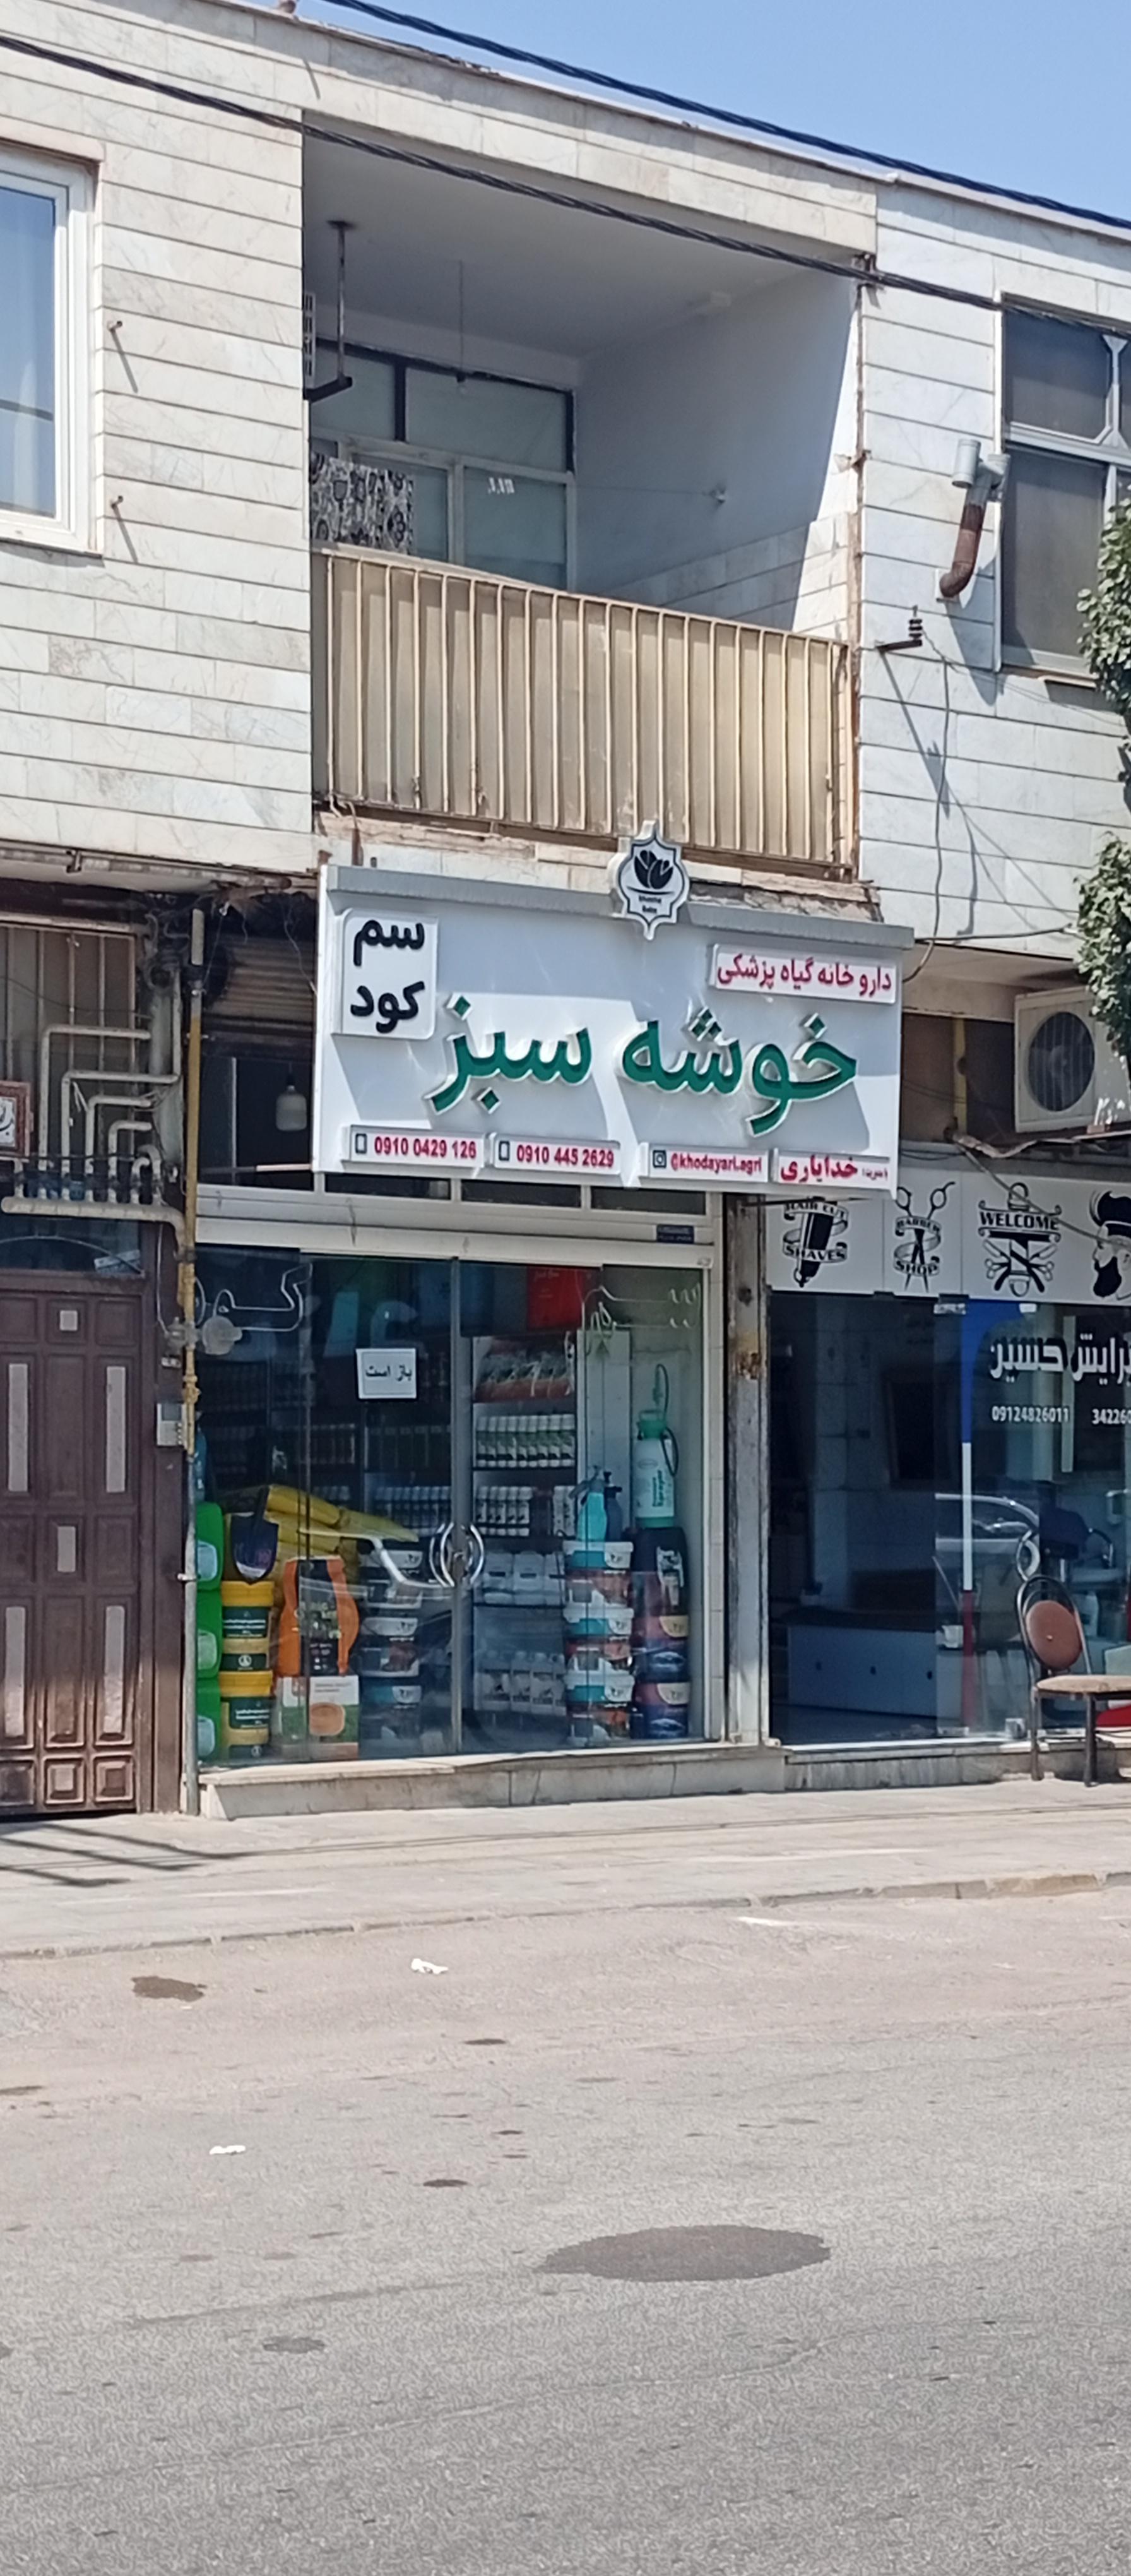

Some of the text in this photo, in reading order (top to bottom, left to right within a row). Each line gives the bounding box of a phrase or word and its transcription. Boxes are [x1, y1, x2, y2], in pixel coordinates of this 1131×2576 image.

[353, 919, 425, 967] سم
[717, 951, 892, 996] دارو خانه گیاه پزشکی
[350, 981, 425, 1034] کود
[428, 995, 857, 1136] خوشه سبز
[374, 1136, 477, 1159] 0910 0429 126
[516, 1144, 614, 1167] 0910 445 2629
[780, 1154, 858, 1183] خدایاری
[980, 1212, 1060, 1231] WELCOME
[785, 1244, 846, 1261] SHAVES
[896, 1260, 938, 1275] SHOP
[365, 1364, 413, 1382] باز است
[989, 1343, 1065, 1383] حسین
[992, 1405, 1069, 1423] 09124826011
